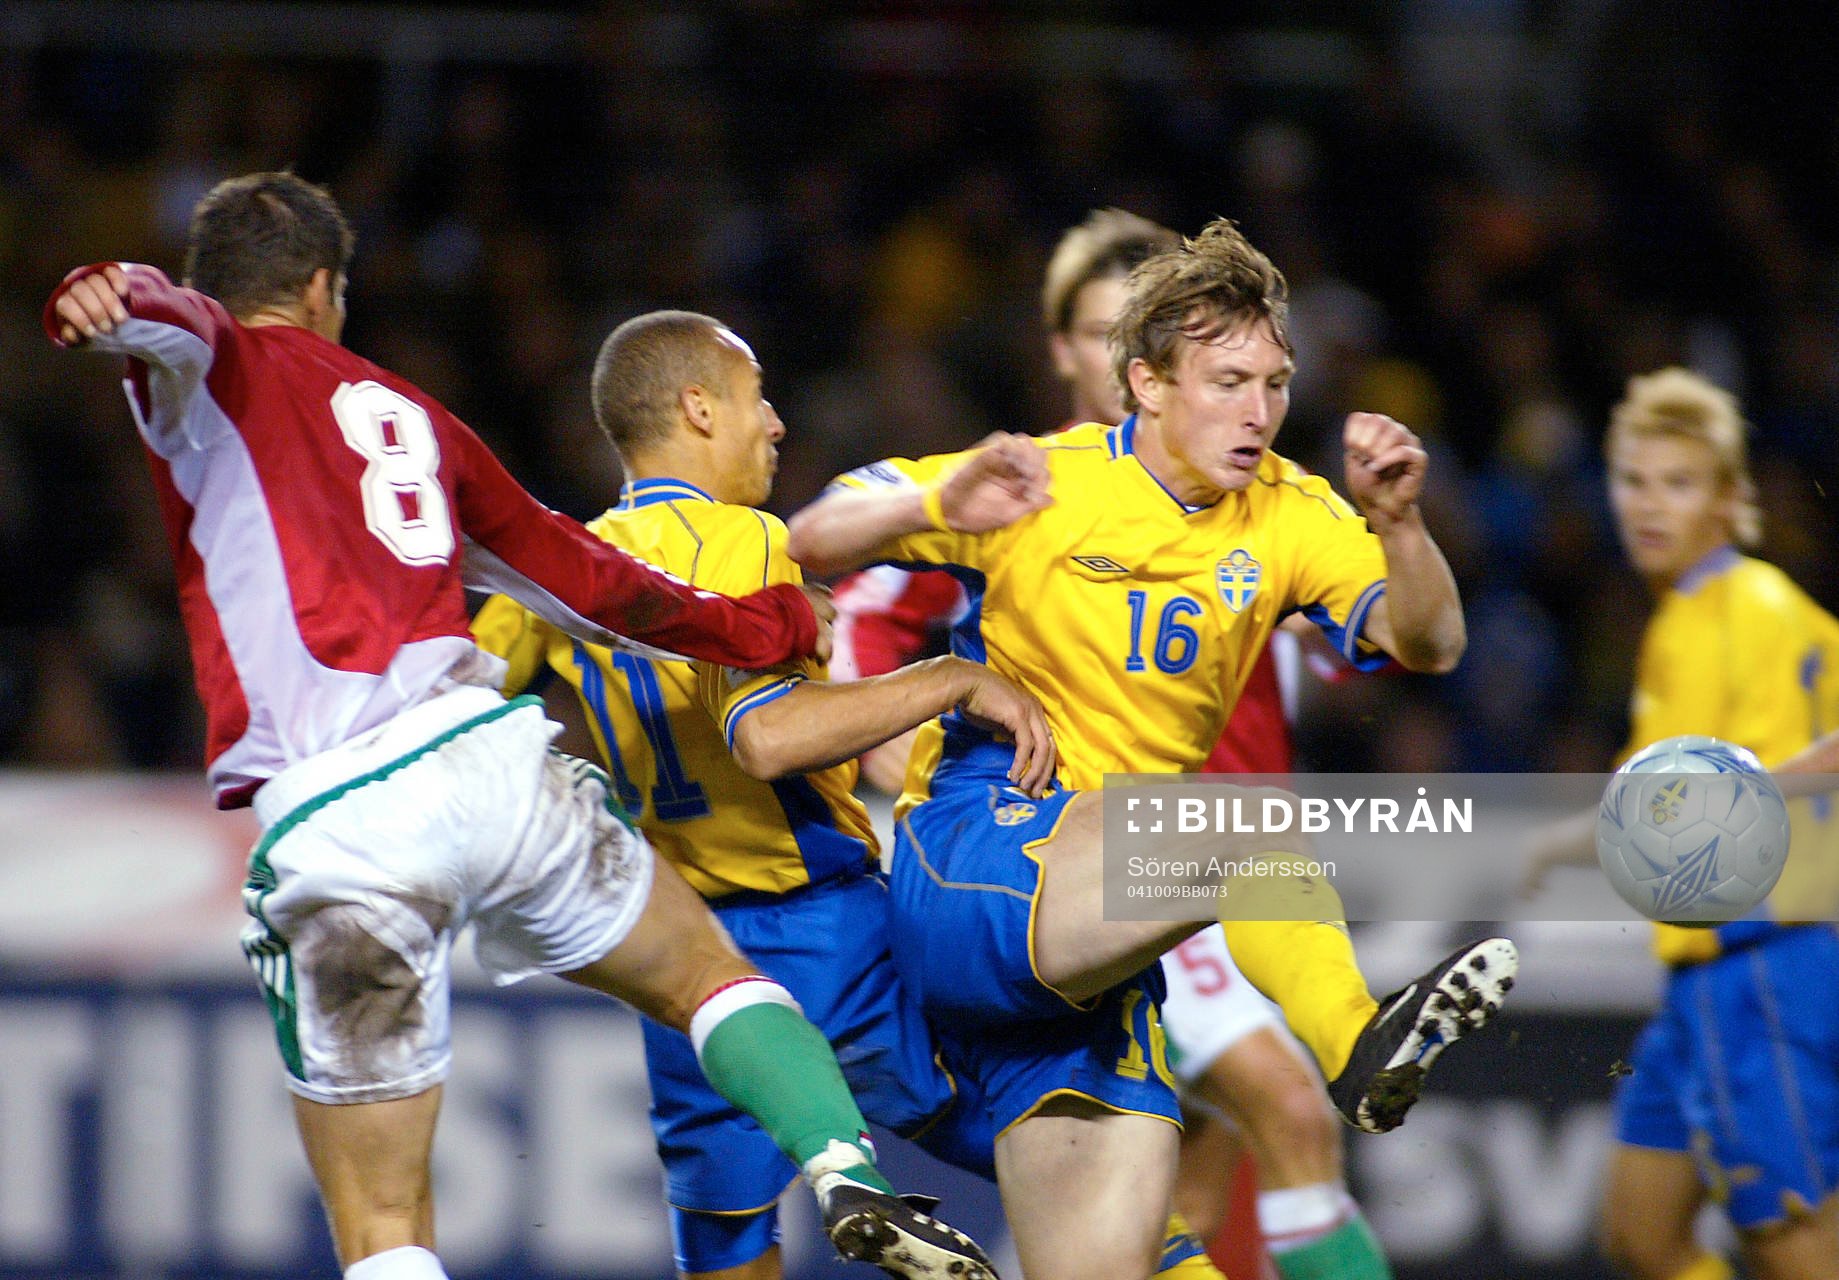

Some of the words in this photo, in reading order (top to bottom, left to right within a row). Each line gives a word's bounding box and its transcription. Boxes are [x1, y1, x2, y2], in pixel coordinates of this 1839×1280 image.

[330, 379, 456, 567] 8
[1126, 590, 1202, 675] 16
[572, 638, 712, 821] 11
[1173, 933, 1231, 998] 5
